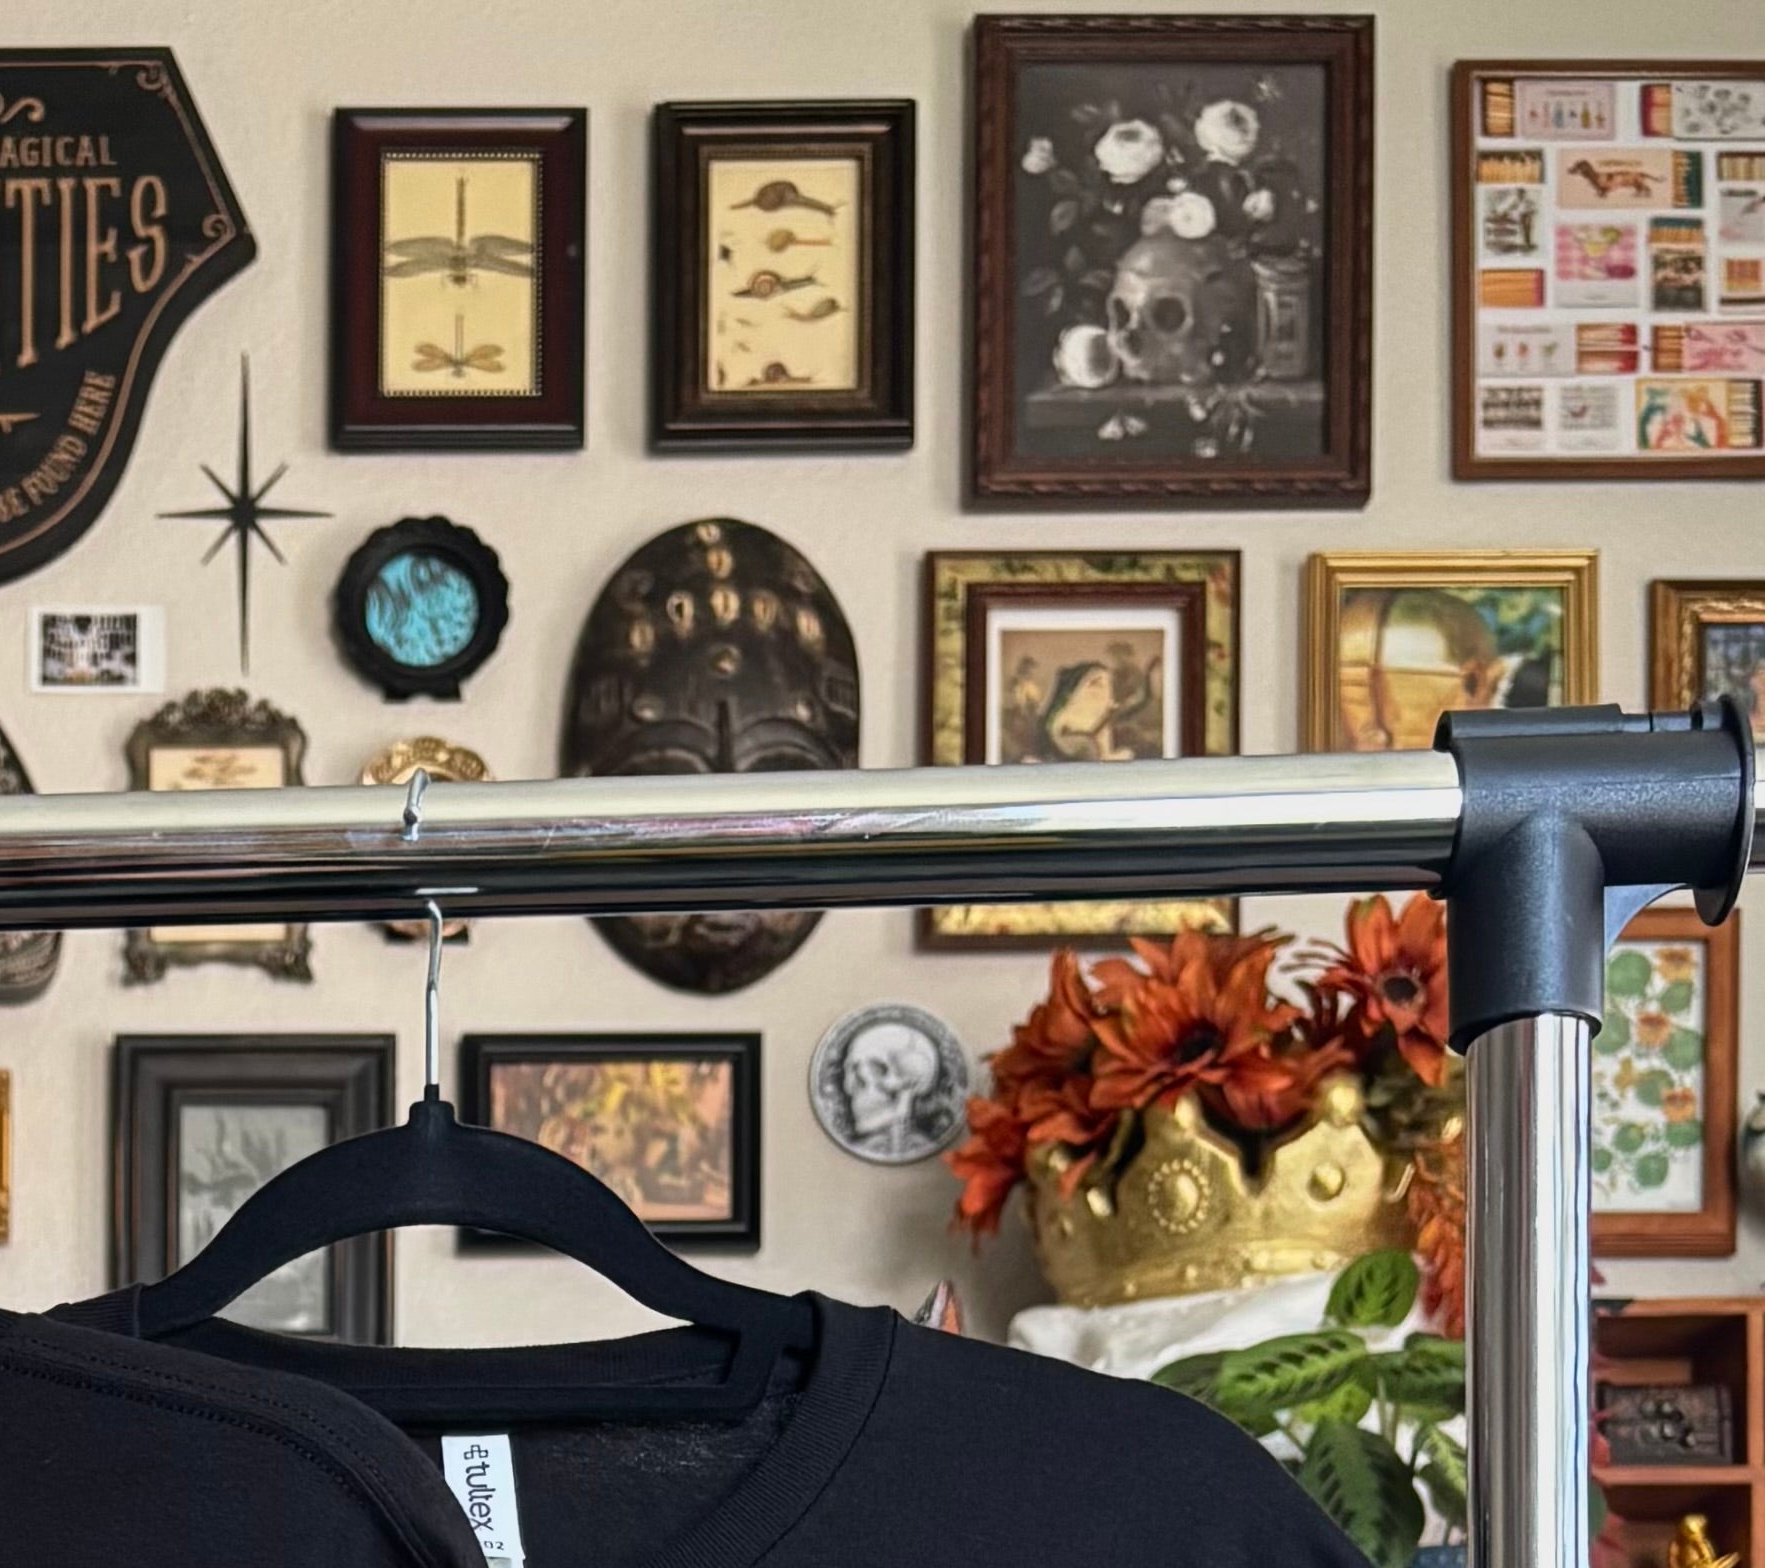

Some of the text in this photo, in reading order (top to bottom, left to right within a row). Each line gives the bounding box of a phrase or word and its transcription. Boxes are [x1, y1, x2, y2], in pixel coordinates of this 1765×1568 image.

[22, 434, 88, 505] FOUND
[67, 370, 116, 436] HERE
[465, 1461, 496, 1532] tultex
